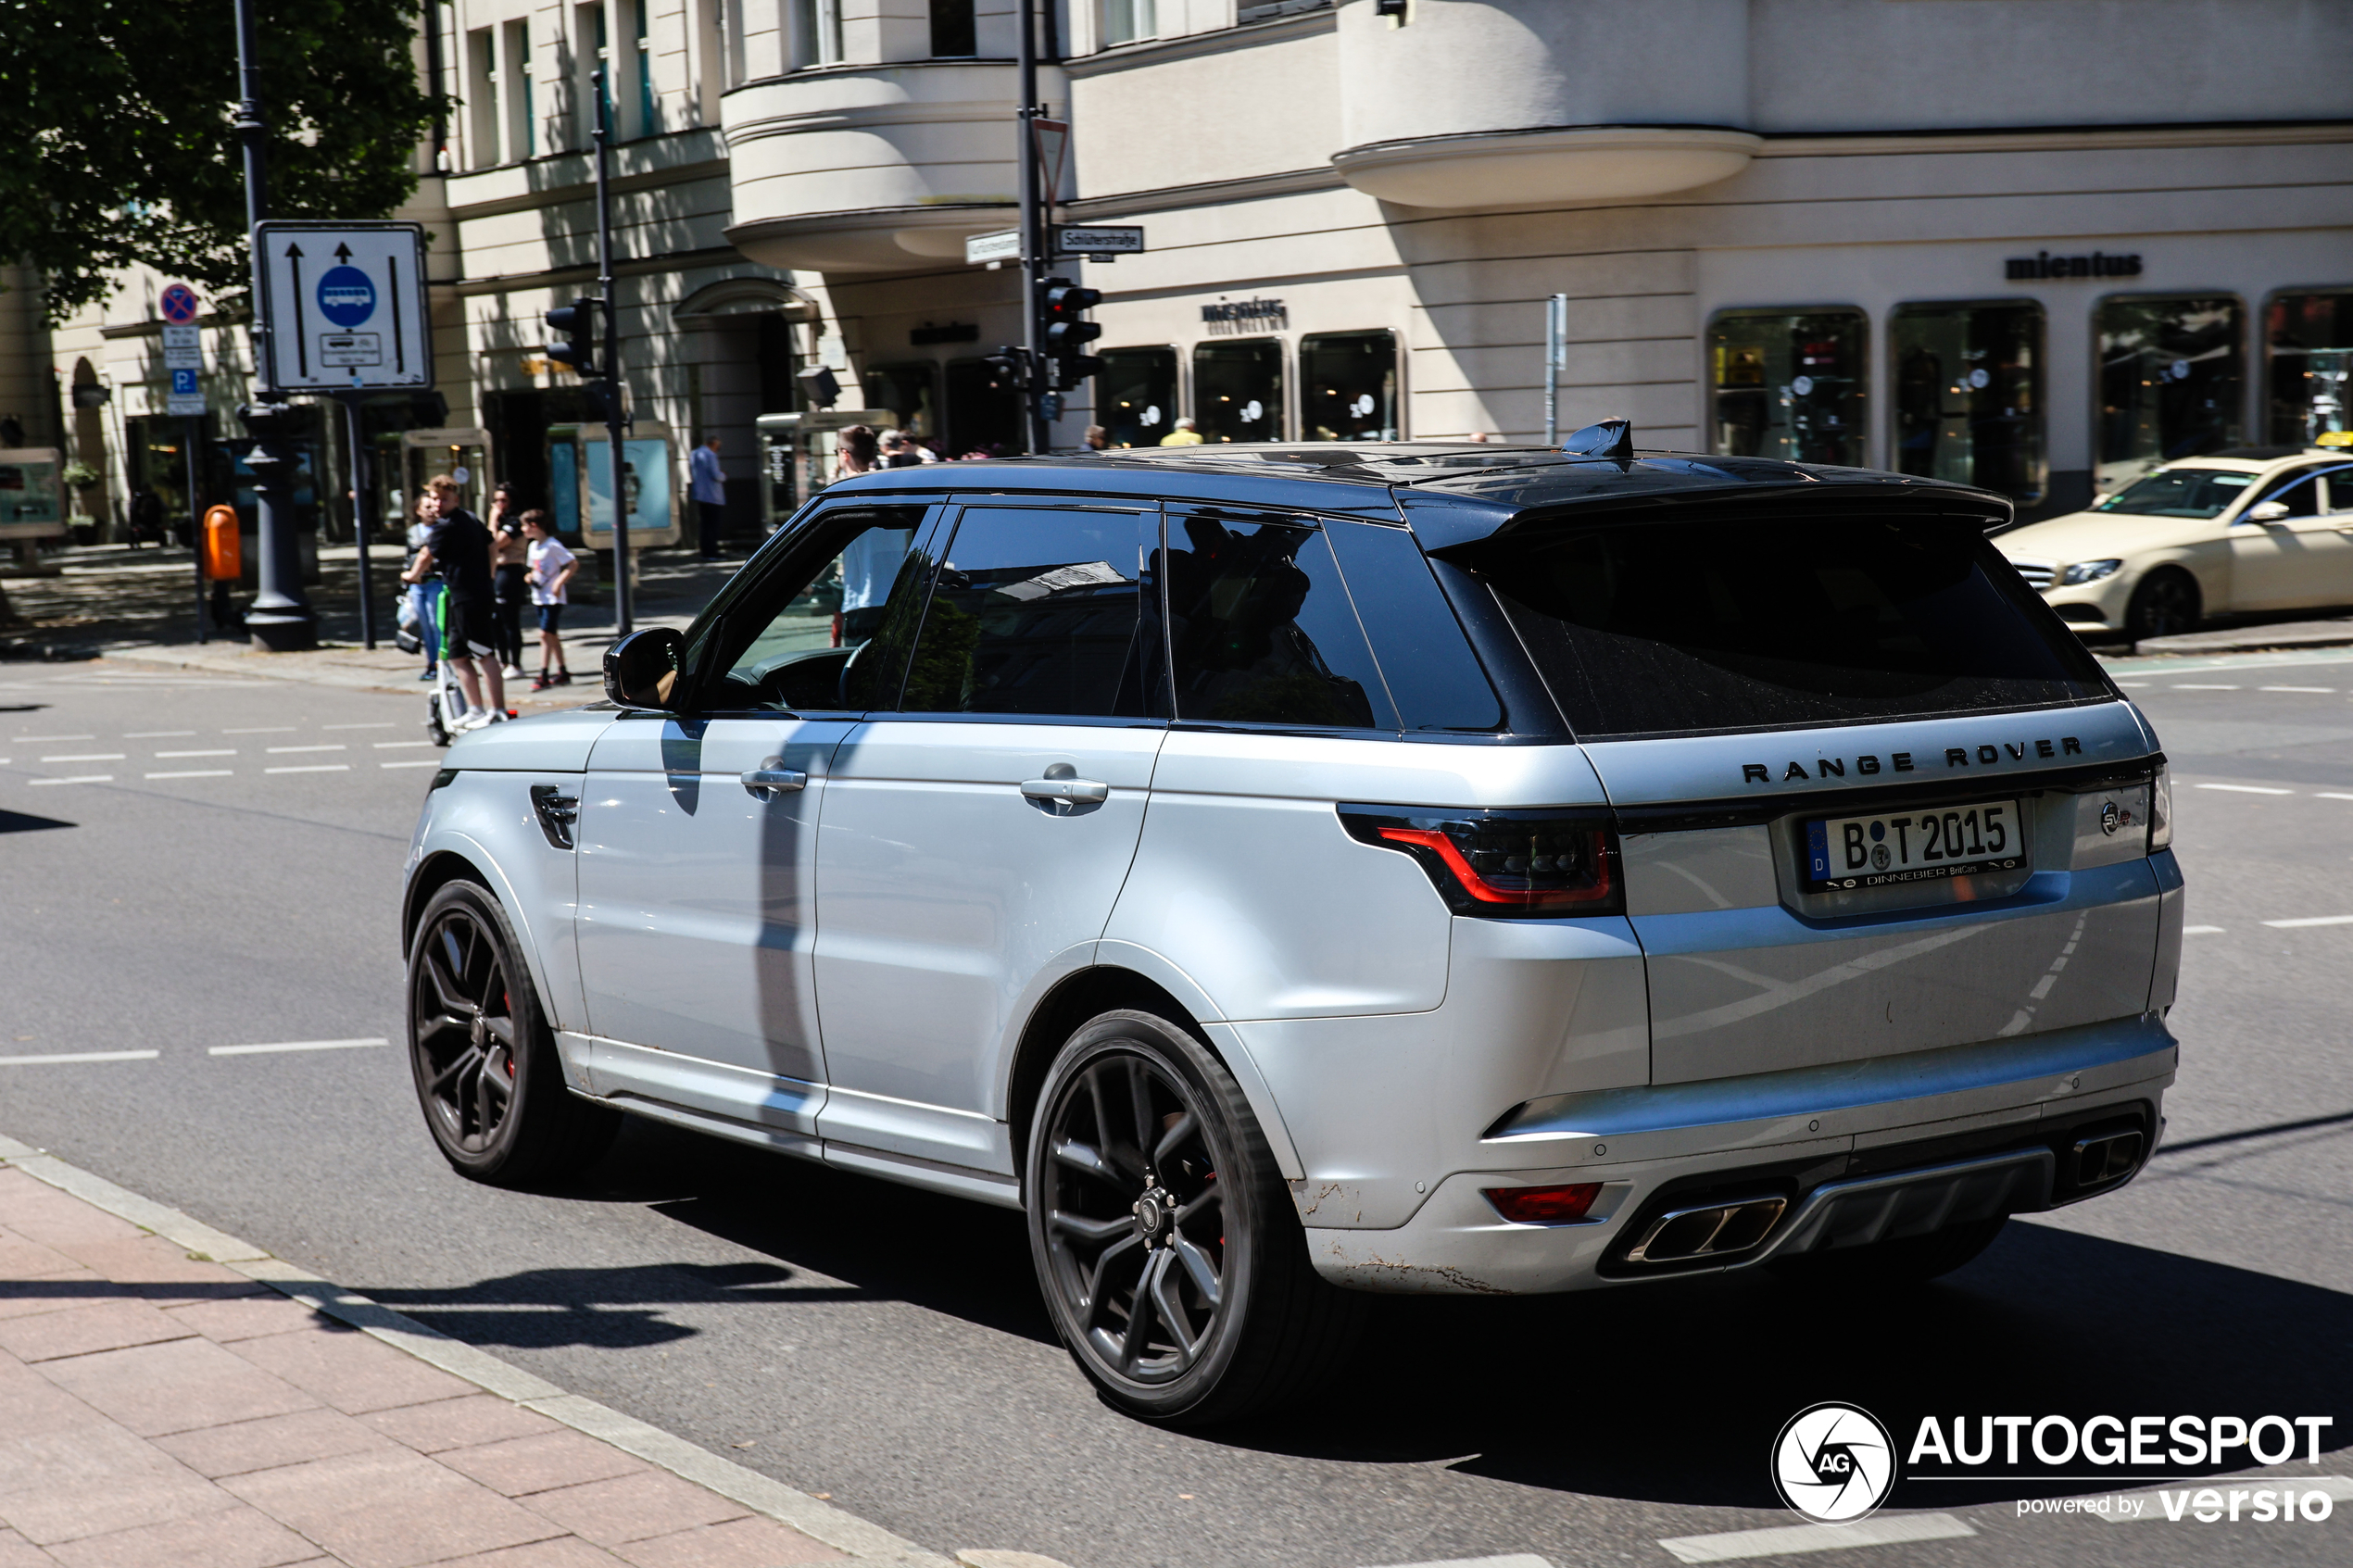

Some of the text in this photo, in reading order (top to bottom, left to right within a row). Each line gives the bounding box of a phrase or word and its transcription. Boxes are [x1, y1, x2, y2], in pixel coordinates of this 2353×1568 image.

[2006, 251, 2143, 279] mientus
[1202, 296, 1286, 321] mientus
[1743, 736, 2082, 783] RANGE ROVER
[1815, 858, 1824, 872] D
[1867, 868, 1946, 885] DINNEBIER
[1950, 865, 1978, 875] BritCars
